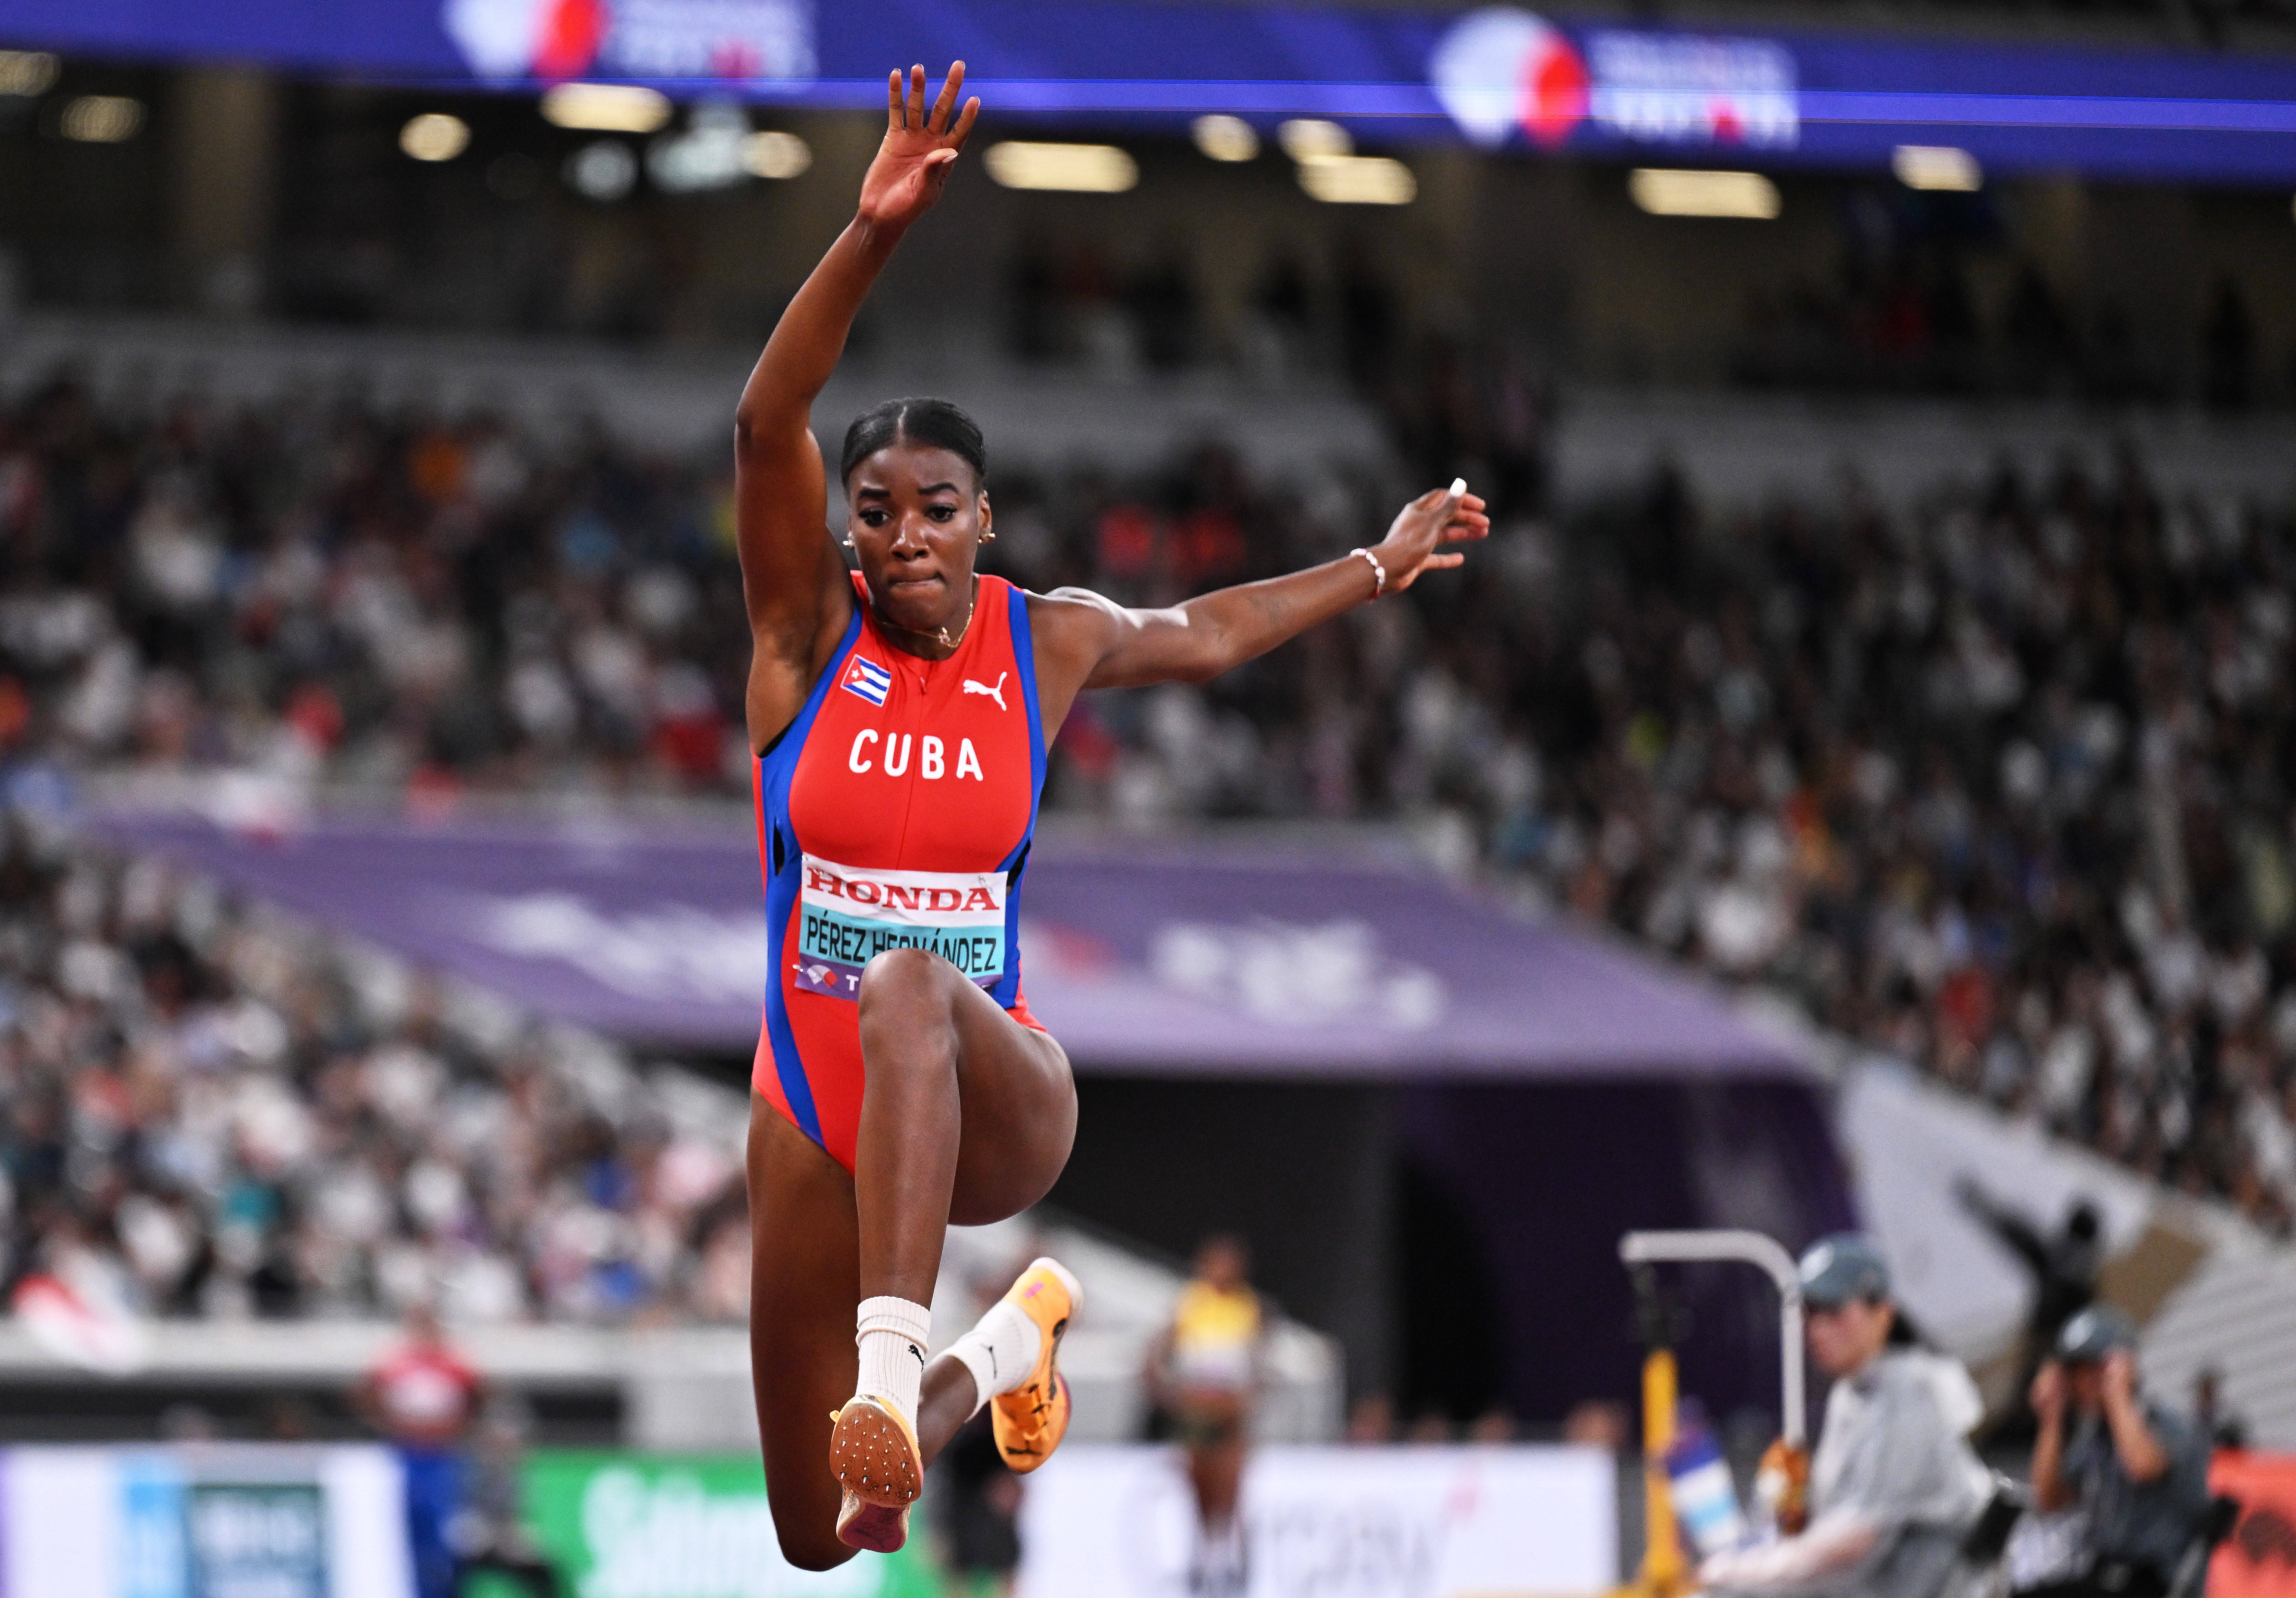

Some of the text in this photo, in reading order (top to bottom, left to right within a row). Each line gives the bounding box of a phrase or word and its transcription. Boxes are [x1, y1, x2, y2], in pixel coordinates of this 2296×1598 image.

[849, 729, 983, 781] CUBA
[807, 866, 1000, 911] HONDA
[806, 909, 866, 962] PÉREZ
